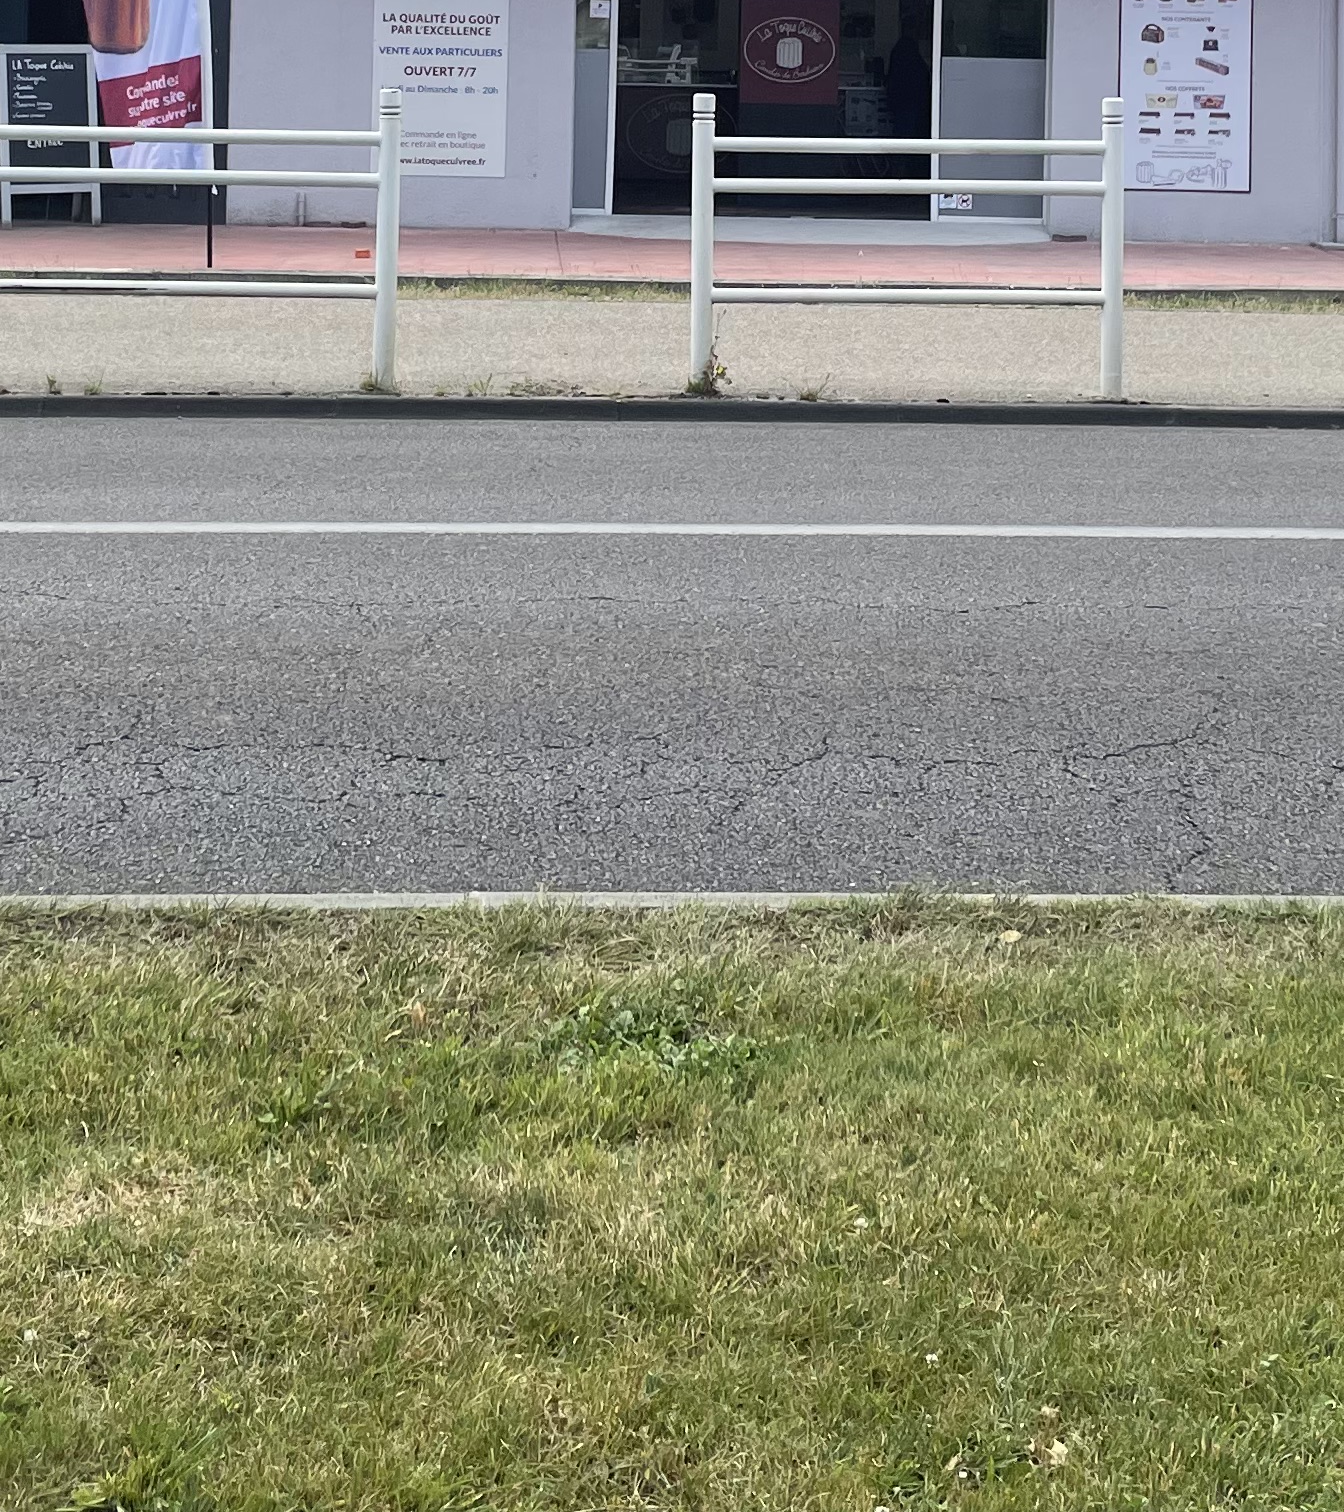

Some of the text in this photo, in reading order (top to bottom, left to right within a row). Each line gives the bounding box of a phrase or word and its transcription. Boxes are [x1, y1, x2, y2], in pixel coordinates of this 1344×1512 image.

[382, 13, 500, 25] LA QUALITÉ DU GOÛT
[391, 25, 492, 36] PAR L'EXCELLENCE
[379, 46, 503, 57] VENTE AUX PARTICULIERS
[404, 66, 477, 77] OUVERT 7/7
[417, 85, 458, 93] Dimanche
[482, 86, 499, 95] 20h
